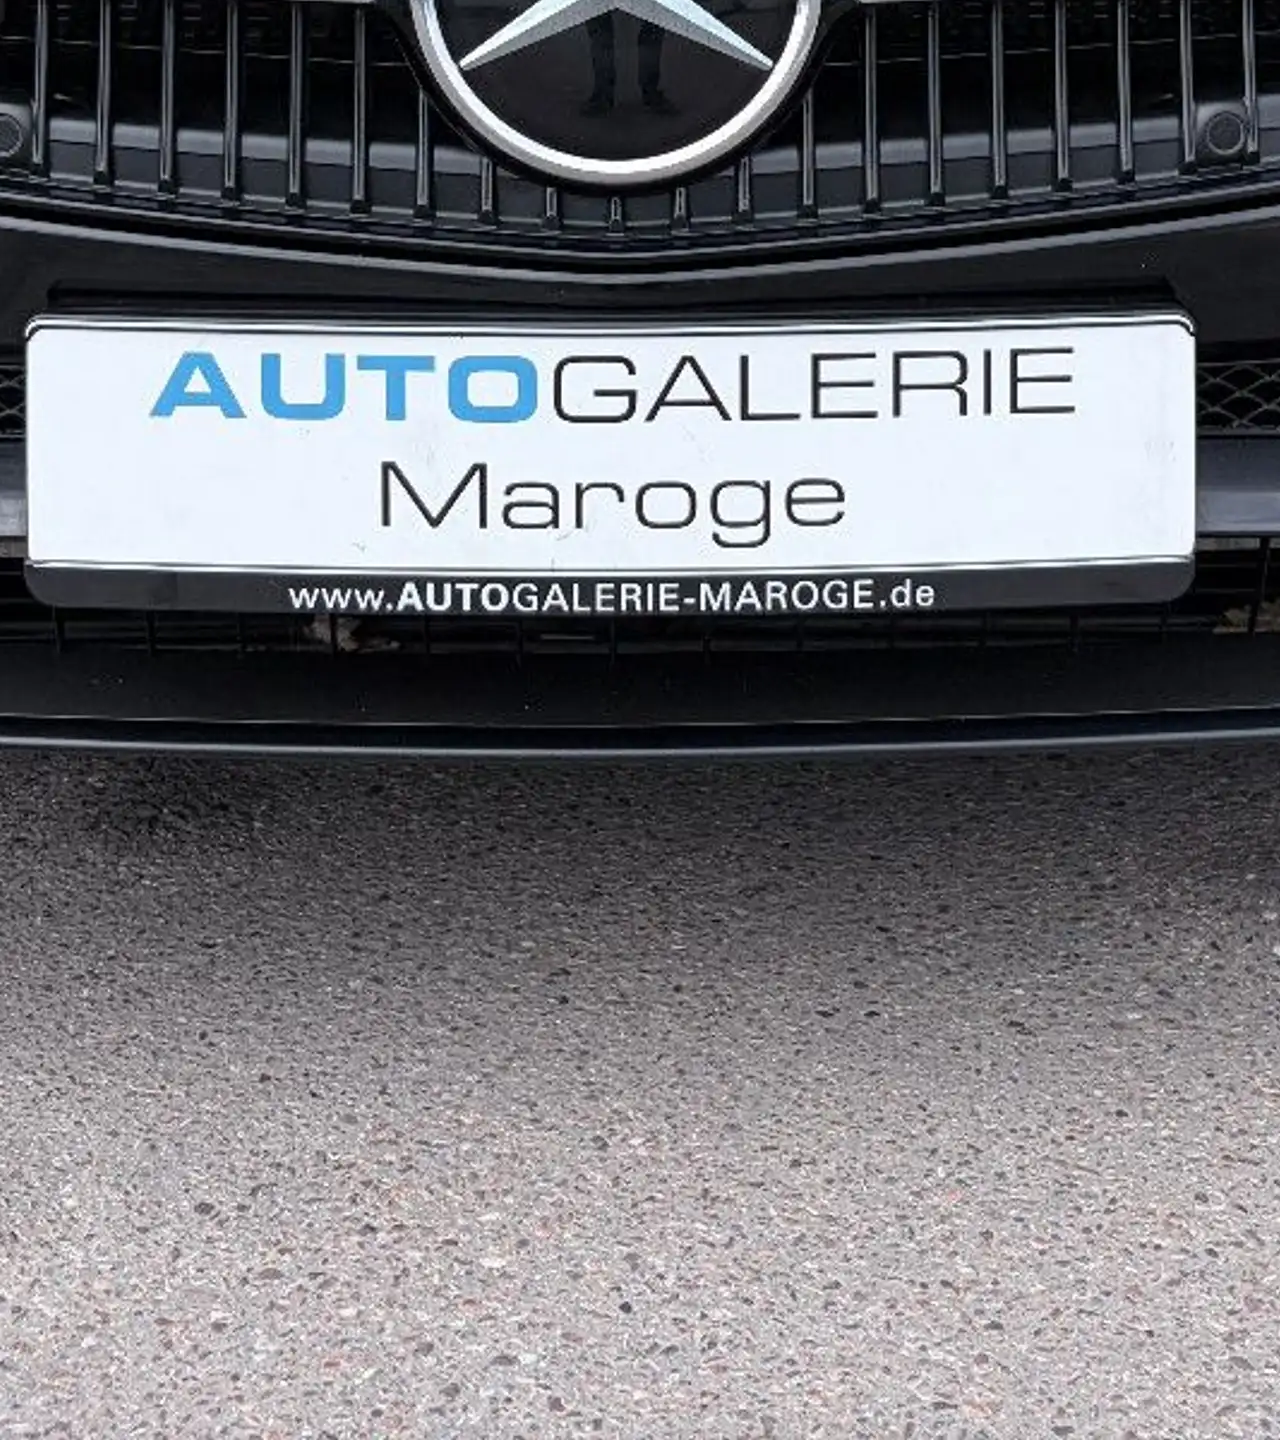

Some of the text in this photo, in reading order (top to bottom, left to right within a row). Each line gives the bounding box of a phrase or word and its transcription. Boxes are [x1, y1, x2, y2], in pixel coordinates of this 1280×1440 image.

[149, 346, 1076, 424] AUTOGALERIE
[380, 460, 846, 549] Maroge
[287, 578, 936, 612] www.AUTOGALERIE-MAROGE.de
